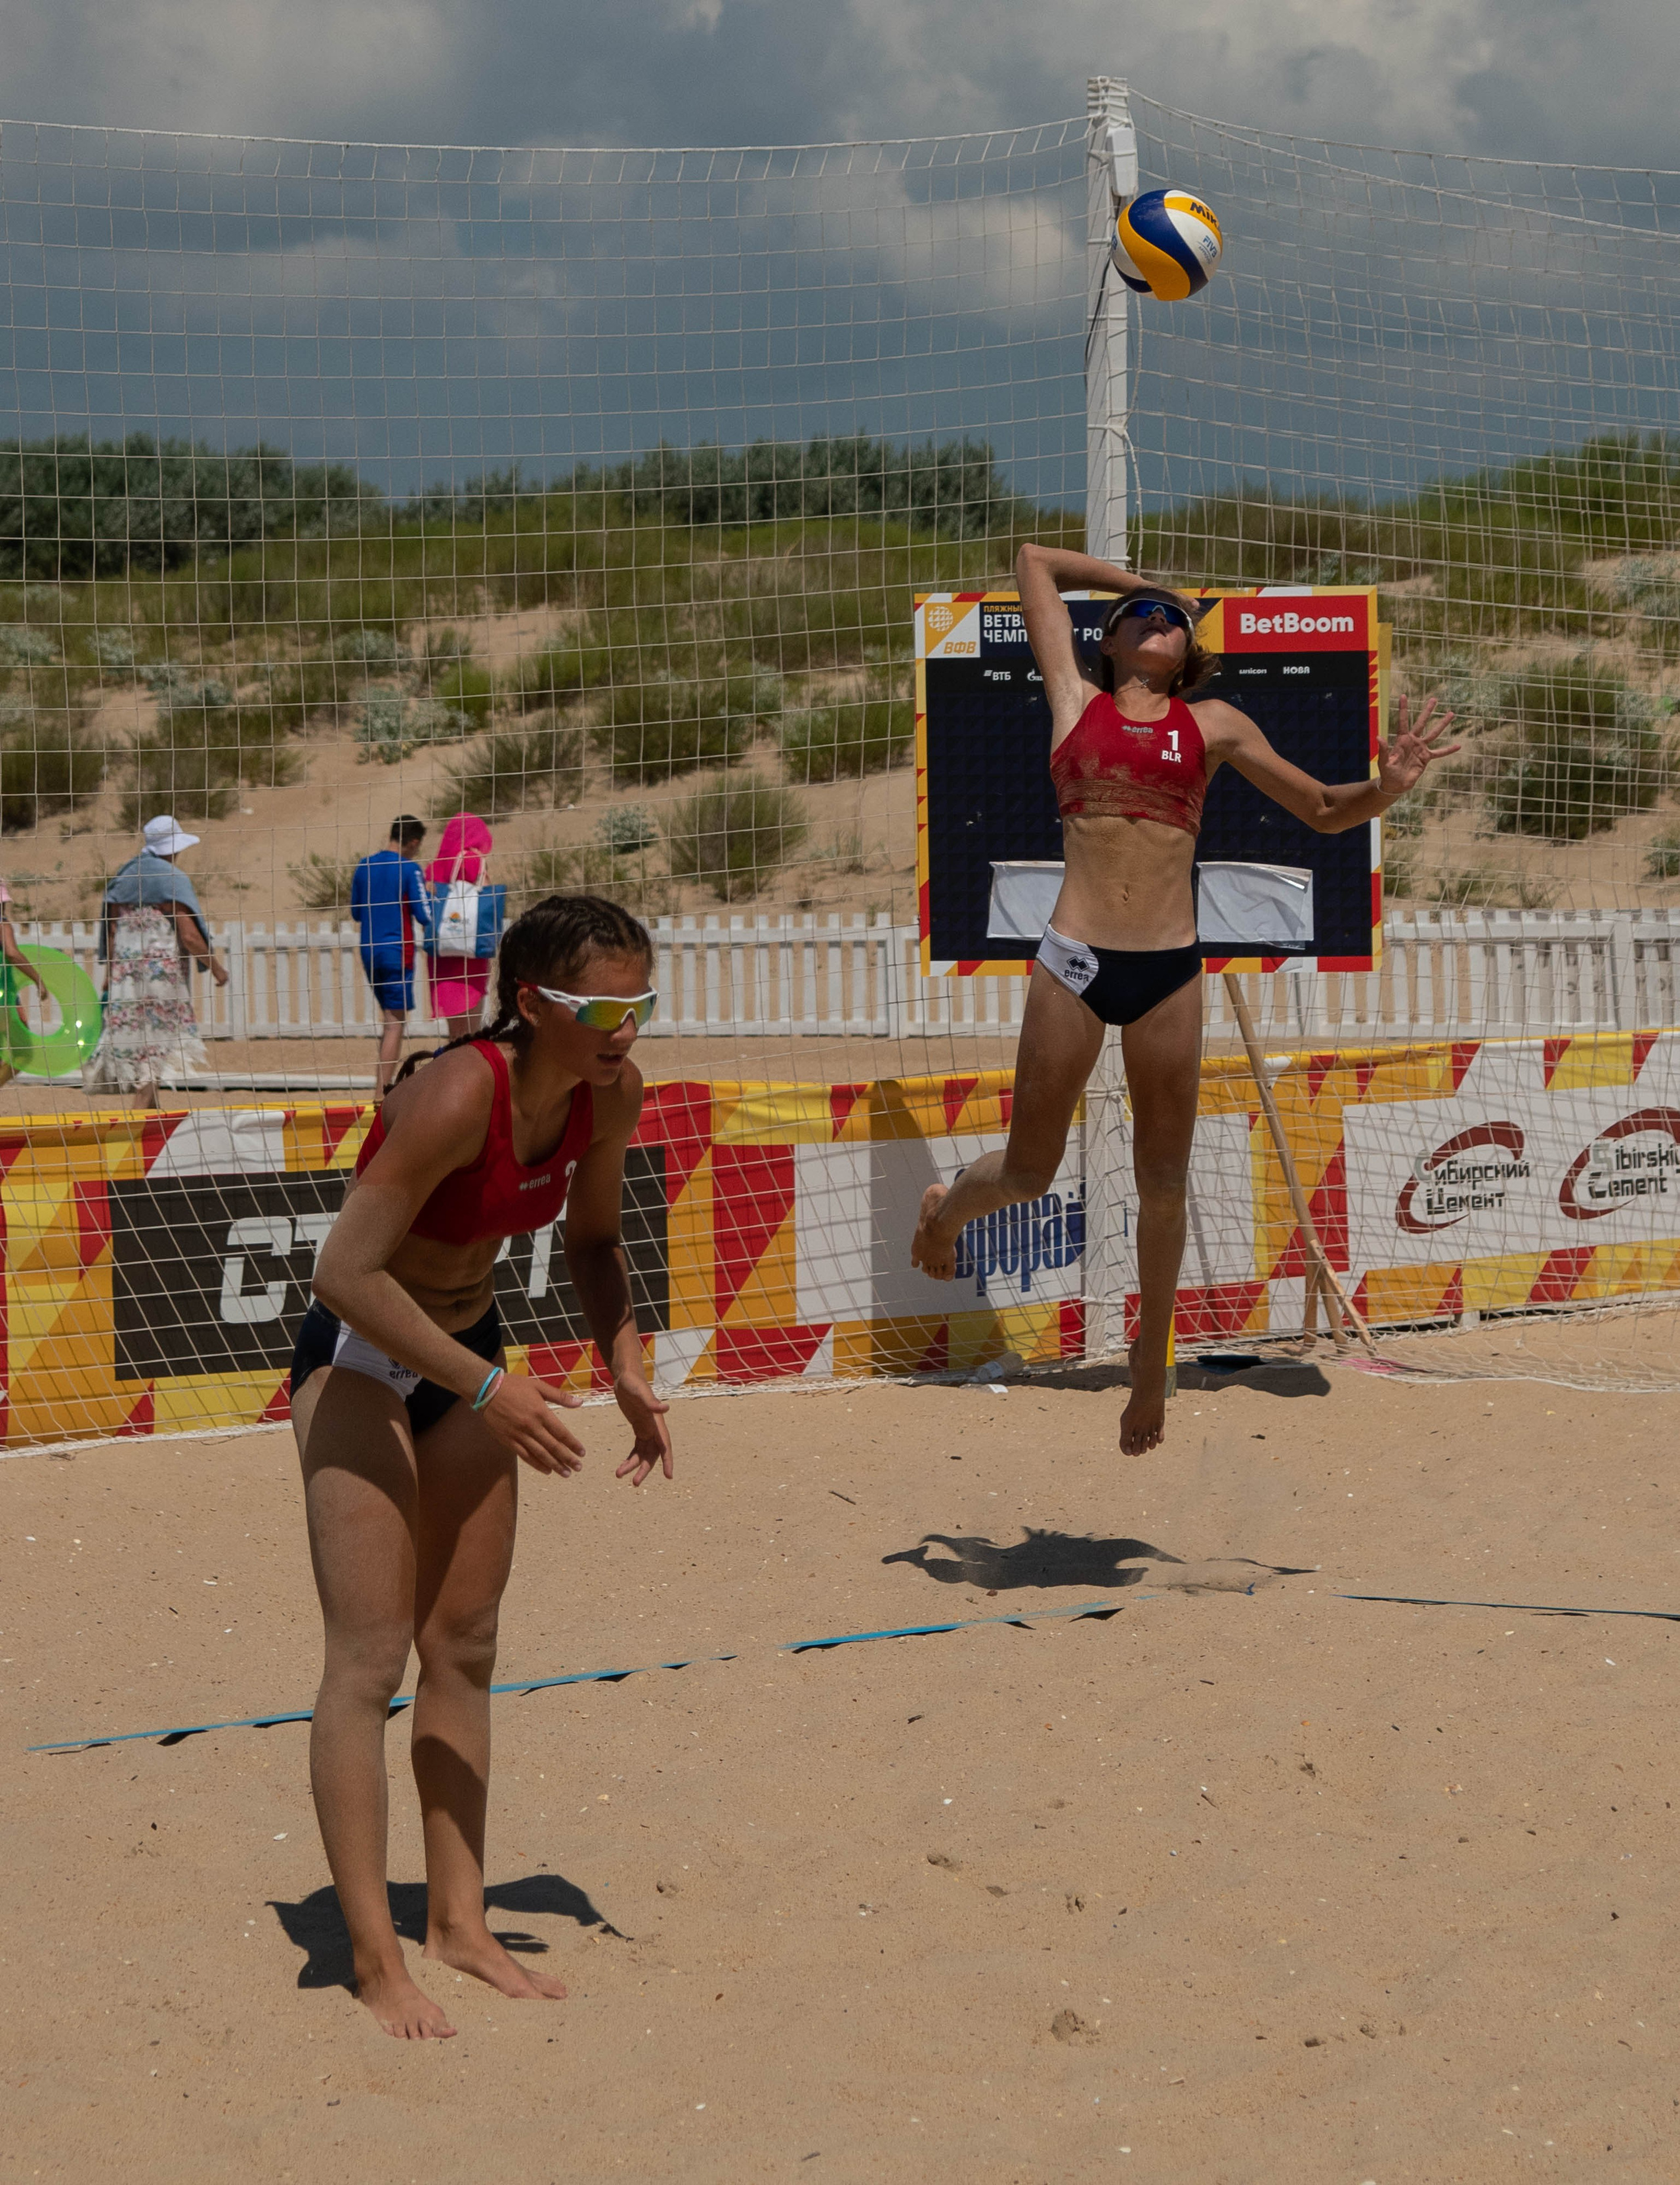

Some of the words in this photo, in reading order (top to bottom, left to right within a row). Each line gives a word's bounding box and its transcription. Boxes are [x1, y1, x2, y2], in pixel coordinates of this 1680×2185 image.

[1240, 612, 1354, 634] BetBoom
[944, 641, 976, 654] ВФВ
[992, 671, 1011, 680] ВТБ
[1167, 730, 1179, 751] 1
[1161, 750, 1182, 763] BLR
[1414, 1148, 1530, 1190] Сибирский
[1587, 1167, 1668, 1199] Cement
[1425, 1187, 1505, 1216] Цемент
